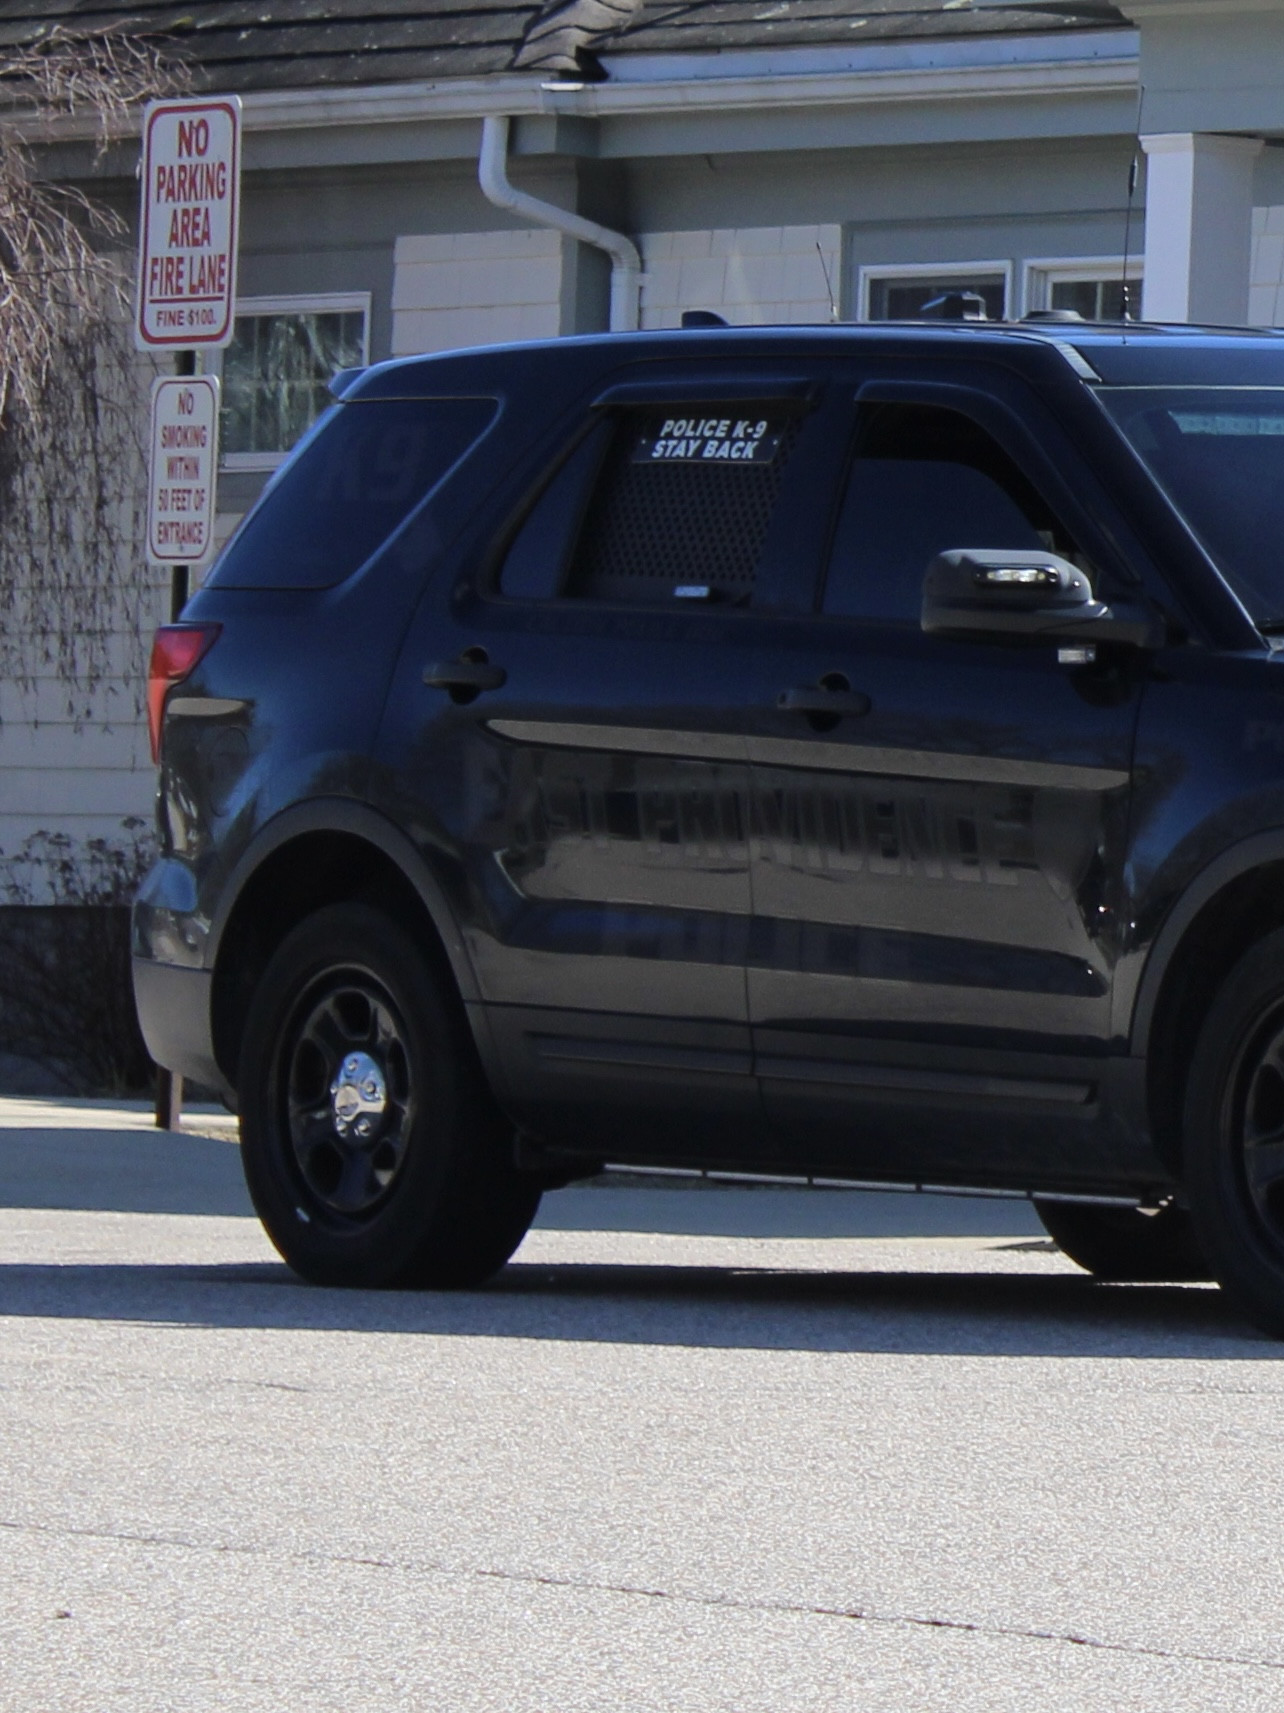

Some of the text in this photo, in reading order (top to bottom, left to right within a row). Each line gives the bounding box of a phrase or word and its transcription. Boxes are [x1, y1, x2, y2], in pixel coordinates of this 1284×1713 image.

[178, 119, 209, 158] NO
[156, 161, 226, 203] PARKING
[169, 207, 211, 249] AREA
[151, 254, 226, 296] FIRE LANE
[156, 310, 185, 327] FINE
[178, 392, 194, 415] NO
[161, 425, 207, 448] SMOKING
[660, 419, 767, 438] POLICE K-9
[651, 440, 759, 459] STAY BACK
[171, 488, 193, 511] FEET
[194, 488, 205, 511] OF
[158, 521, 203, 544] ENTRANCE
